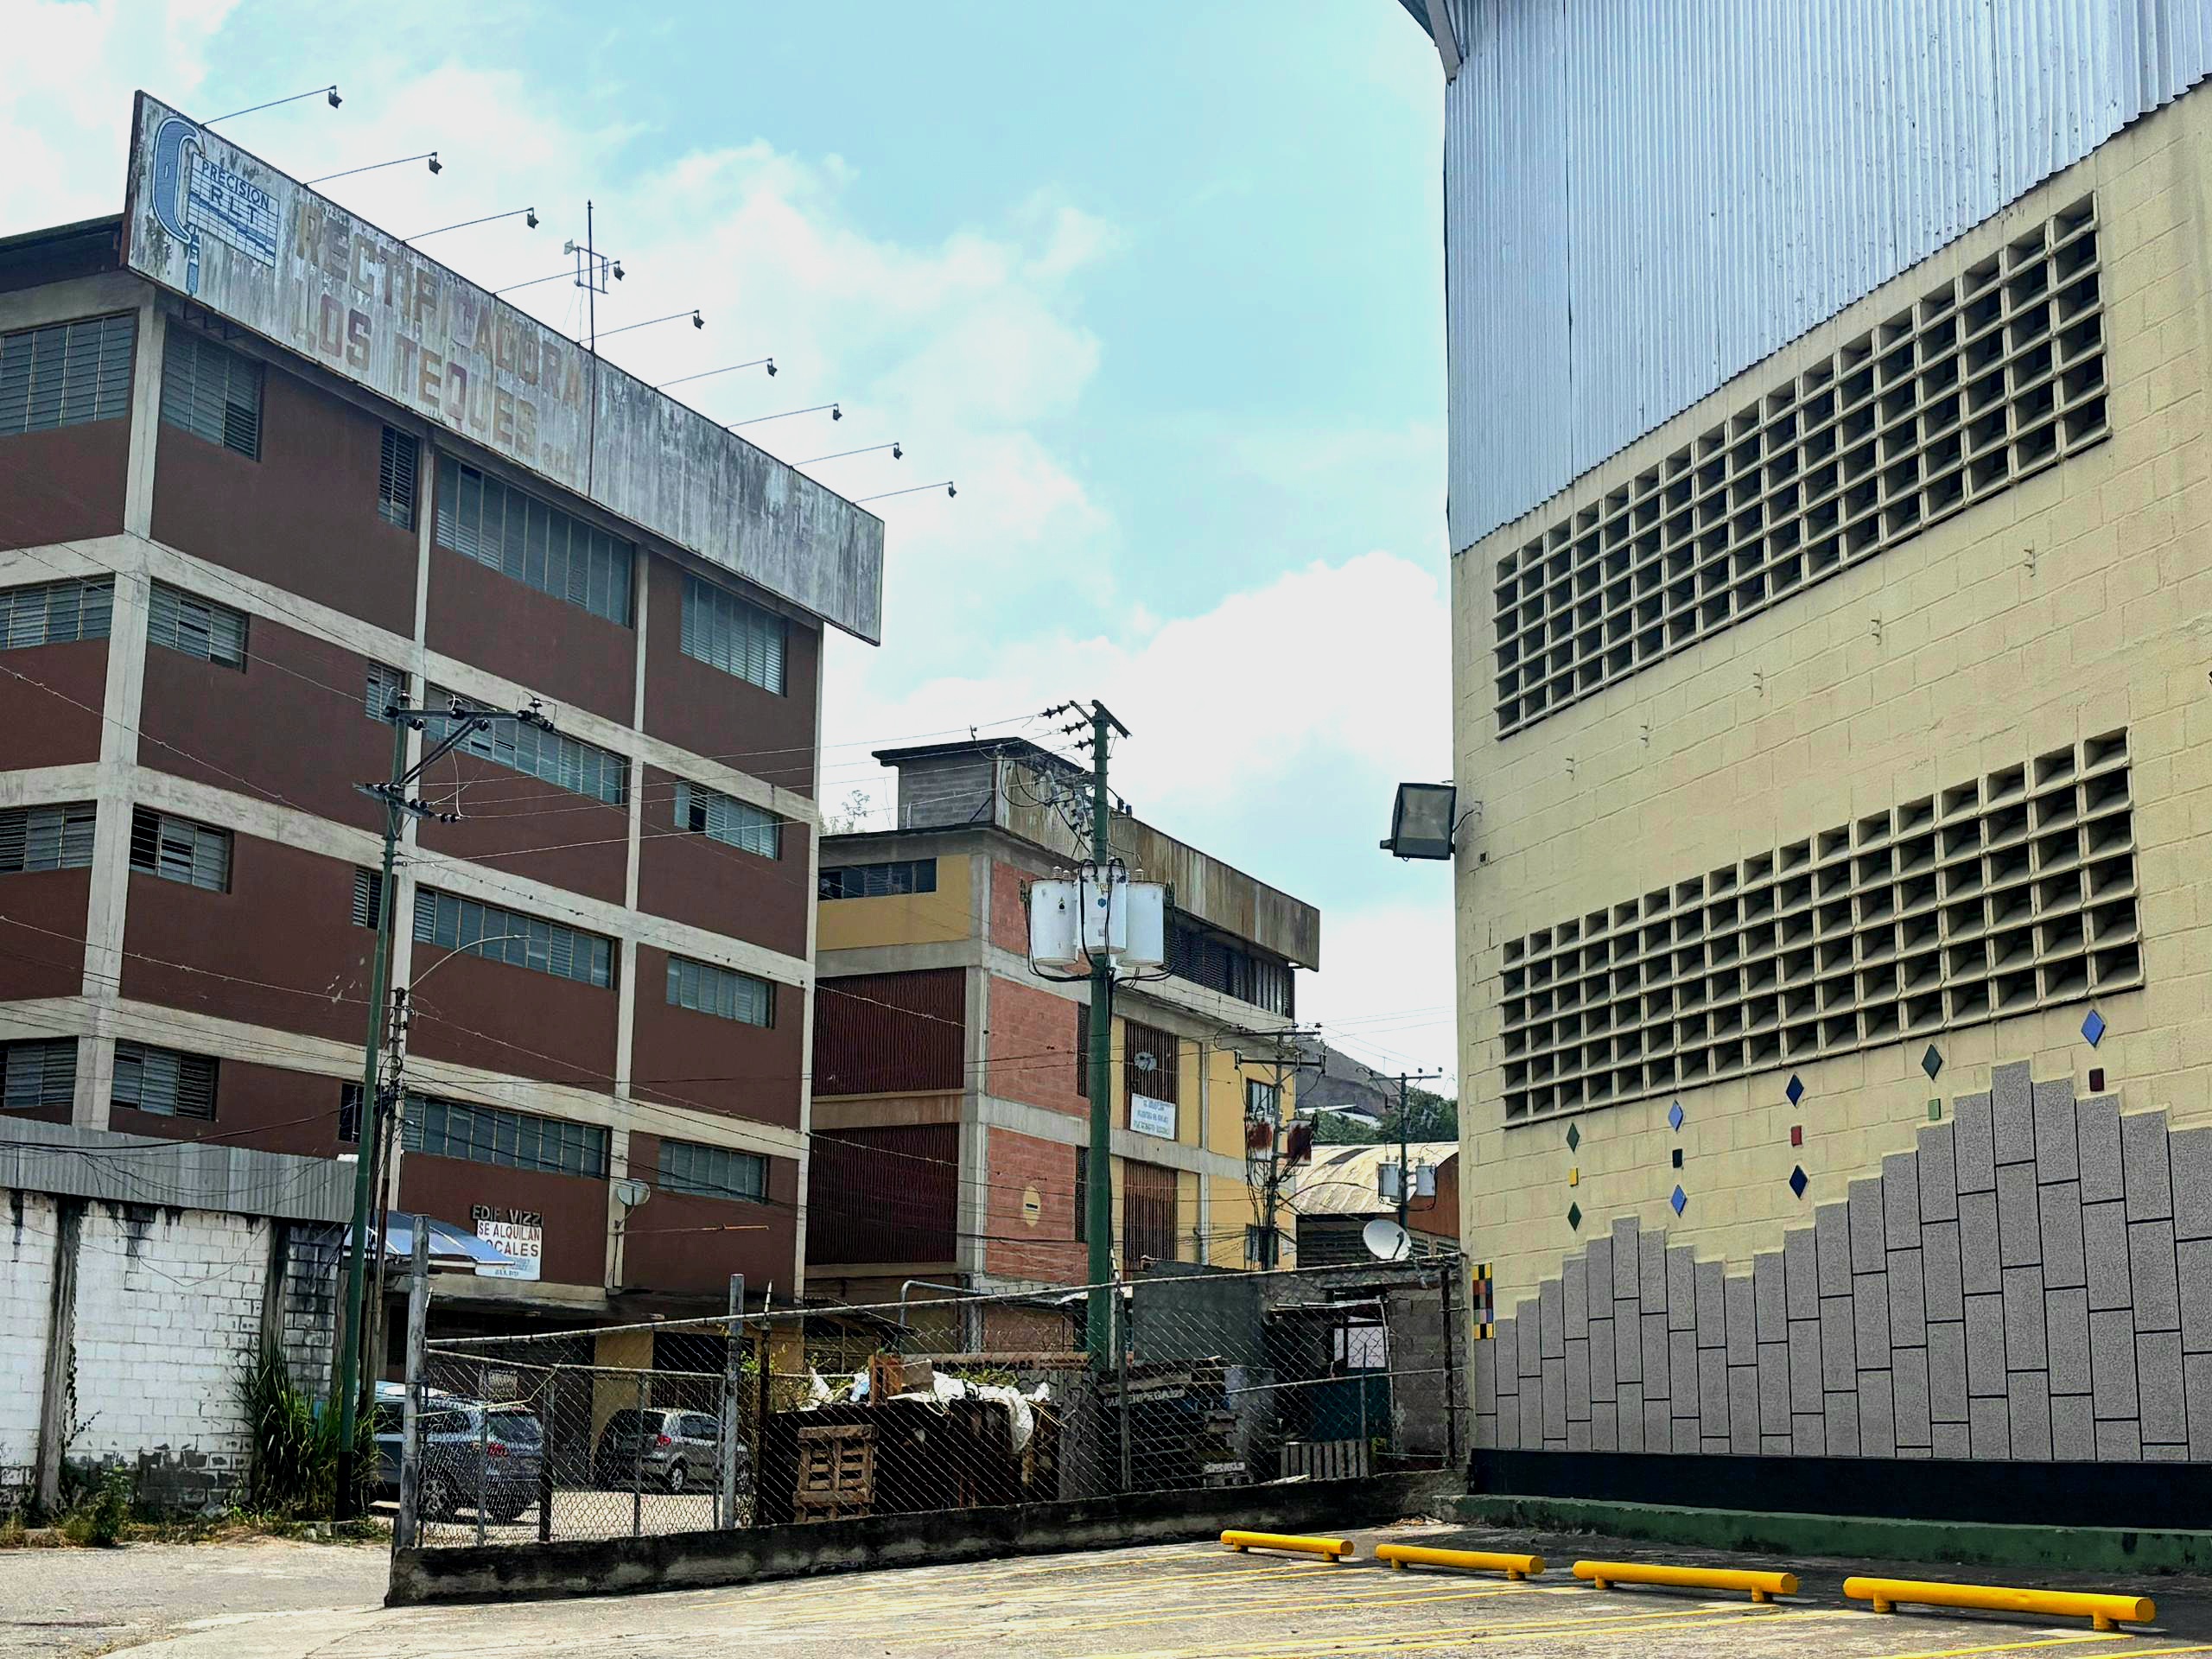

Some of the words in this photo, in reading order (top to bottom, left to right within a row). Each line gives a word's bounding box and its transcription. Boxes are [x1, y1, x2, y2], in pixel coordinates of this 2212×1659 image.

[201, 161, 270, 209] PRECISION
[393, 332, 538, 457] TEQUES
[479, 1222, 490, 1236] SE
[493, 1224, 540, 1241] ALQUILAN
